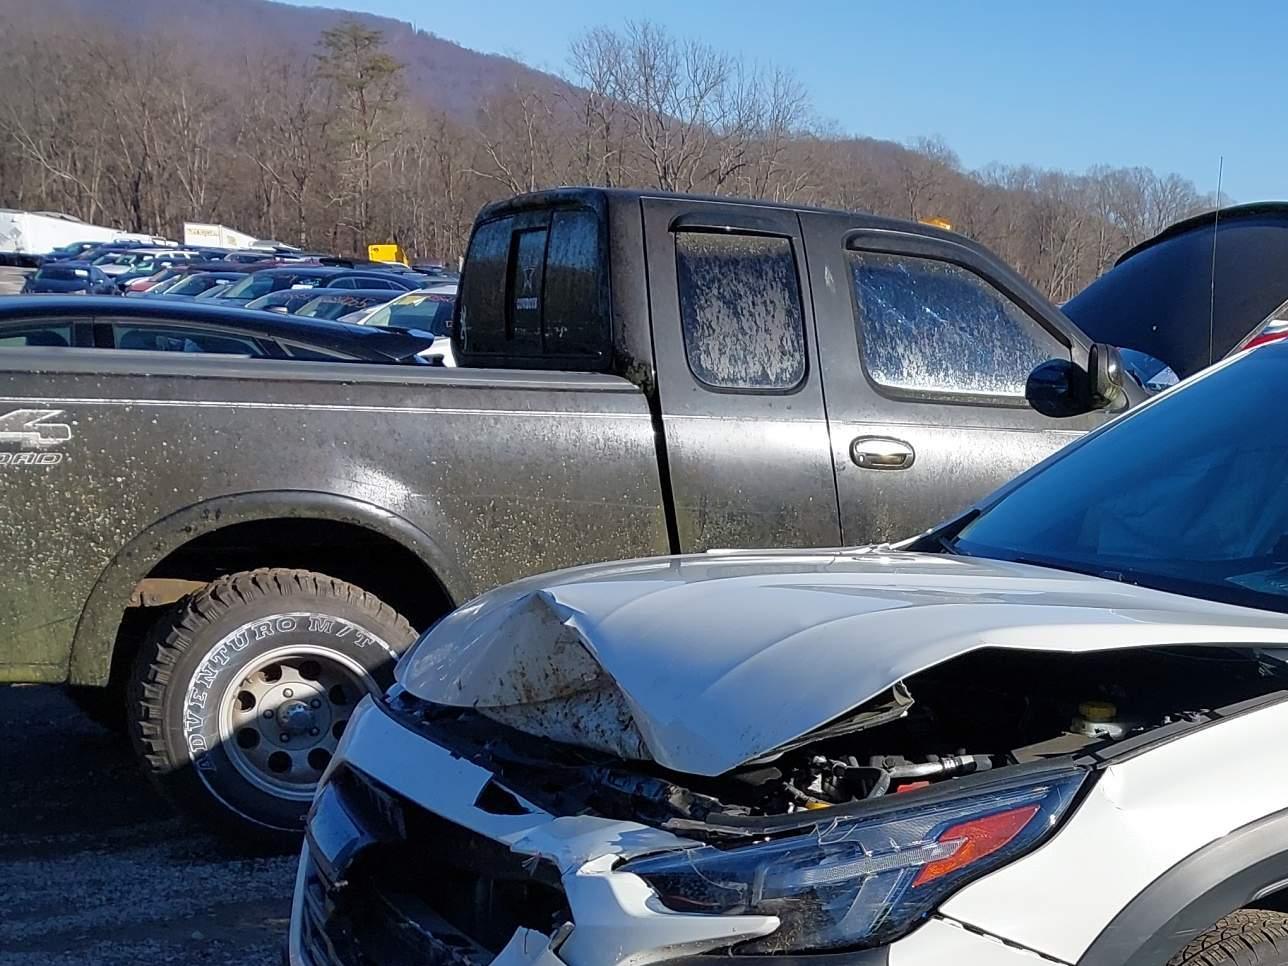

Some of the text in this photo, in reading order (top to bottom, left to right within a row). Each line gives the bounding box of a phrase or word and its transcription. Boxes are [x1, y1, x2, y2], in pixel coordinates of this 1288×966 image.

[0, 452, 63, 465] OAD
[186, 615, 374, 772] ADVENTURO M/T
